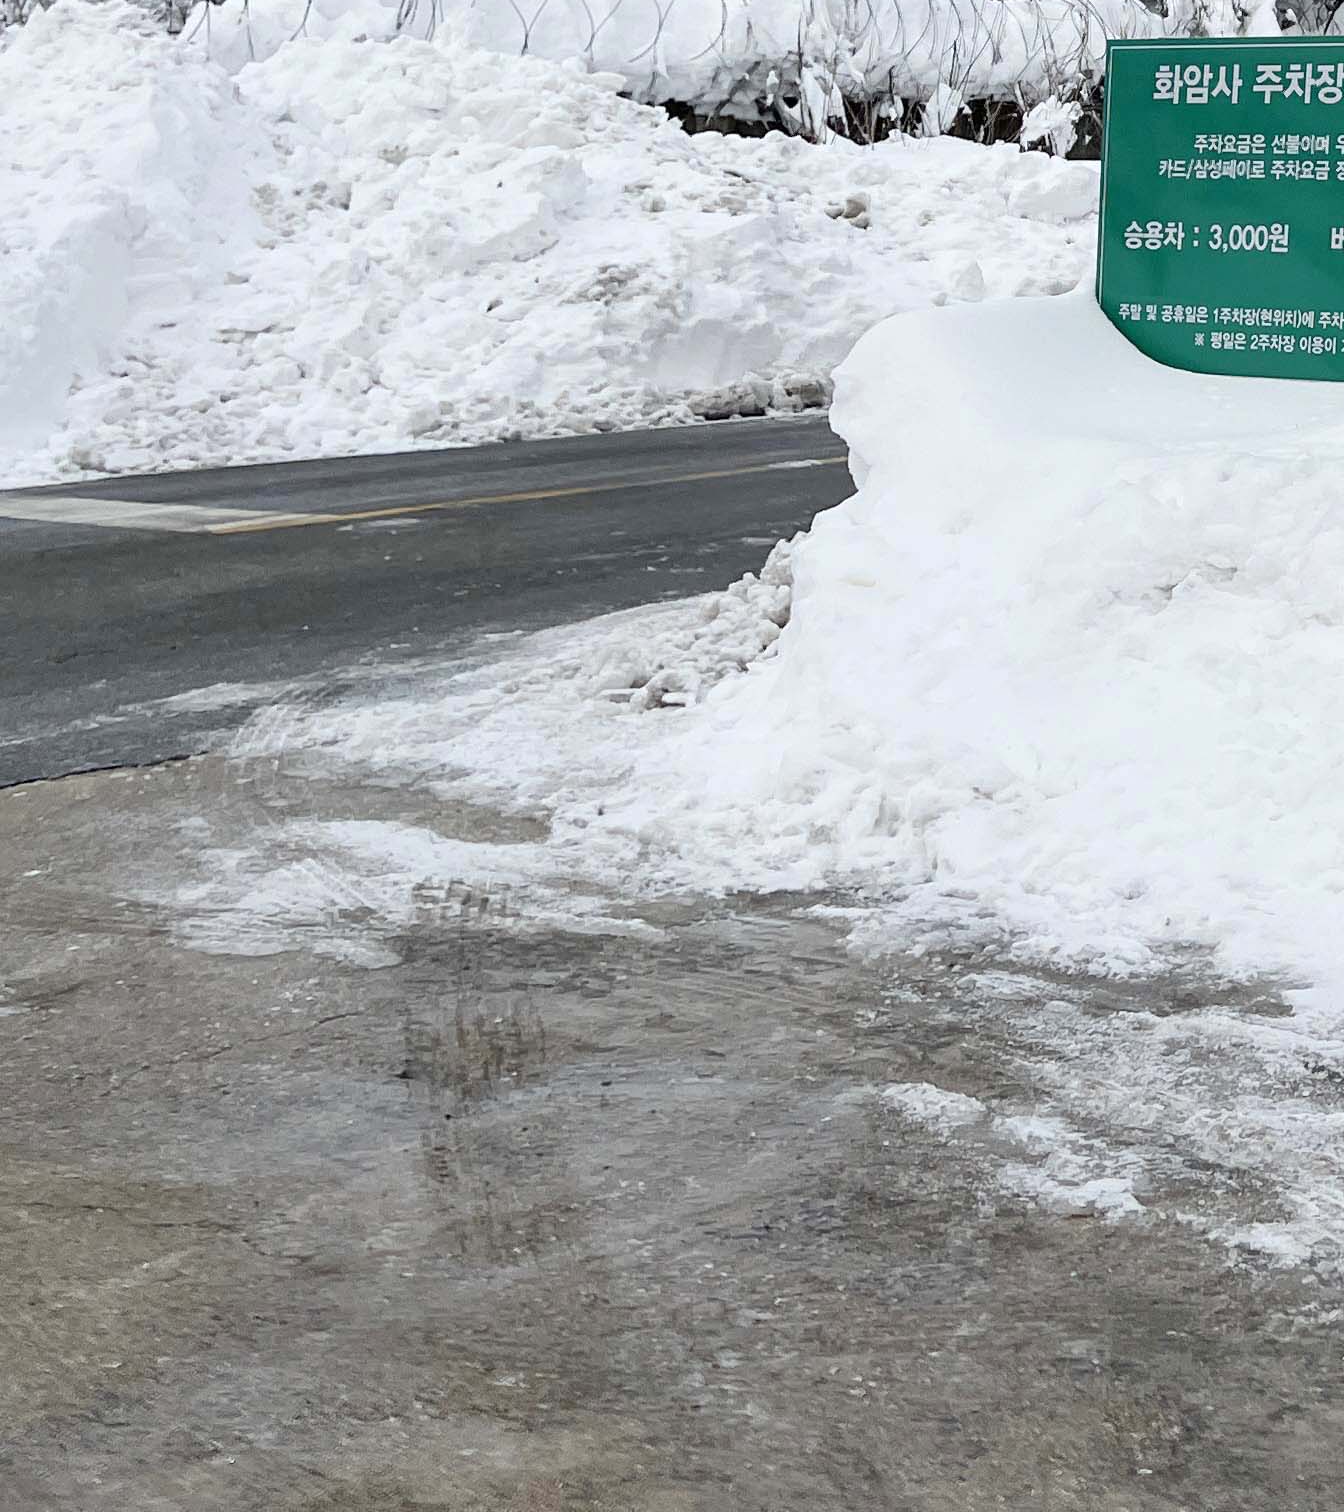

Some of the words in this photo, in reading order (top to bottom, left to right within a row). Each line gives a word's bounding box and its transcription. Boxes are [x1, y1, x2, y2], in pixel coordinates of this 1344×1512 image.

[1153, 63, 1243, 105] 화암사
[1193, 134, 1267, 154] 주차요금은
[1271, 134, 1330, 155] 선불이며
[1159, 158, 1266, 180] 카드/삼성페이로
[1270, 159, 1331, 181] 주차요금
[1124, 220, 1185, 251] 승용차
[1208, 223, 1289, 253] 3,000원
[1118, 303, 1142, 321] 주말
[1145, 304, 1157, 321] 및
[1160, 304, 1209, 324] 공휴일은
[1212, 307, 1315, 330] 1주차장(현위치)에
[1318, 311, 1344, 330] 주차
[1210, 331, 1247, 350] 평일은
[1250, 334, 1296, 353] 2주차장
[1299, 335, 1337, 355] 이용이
